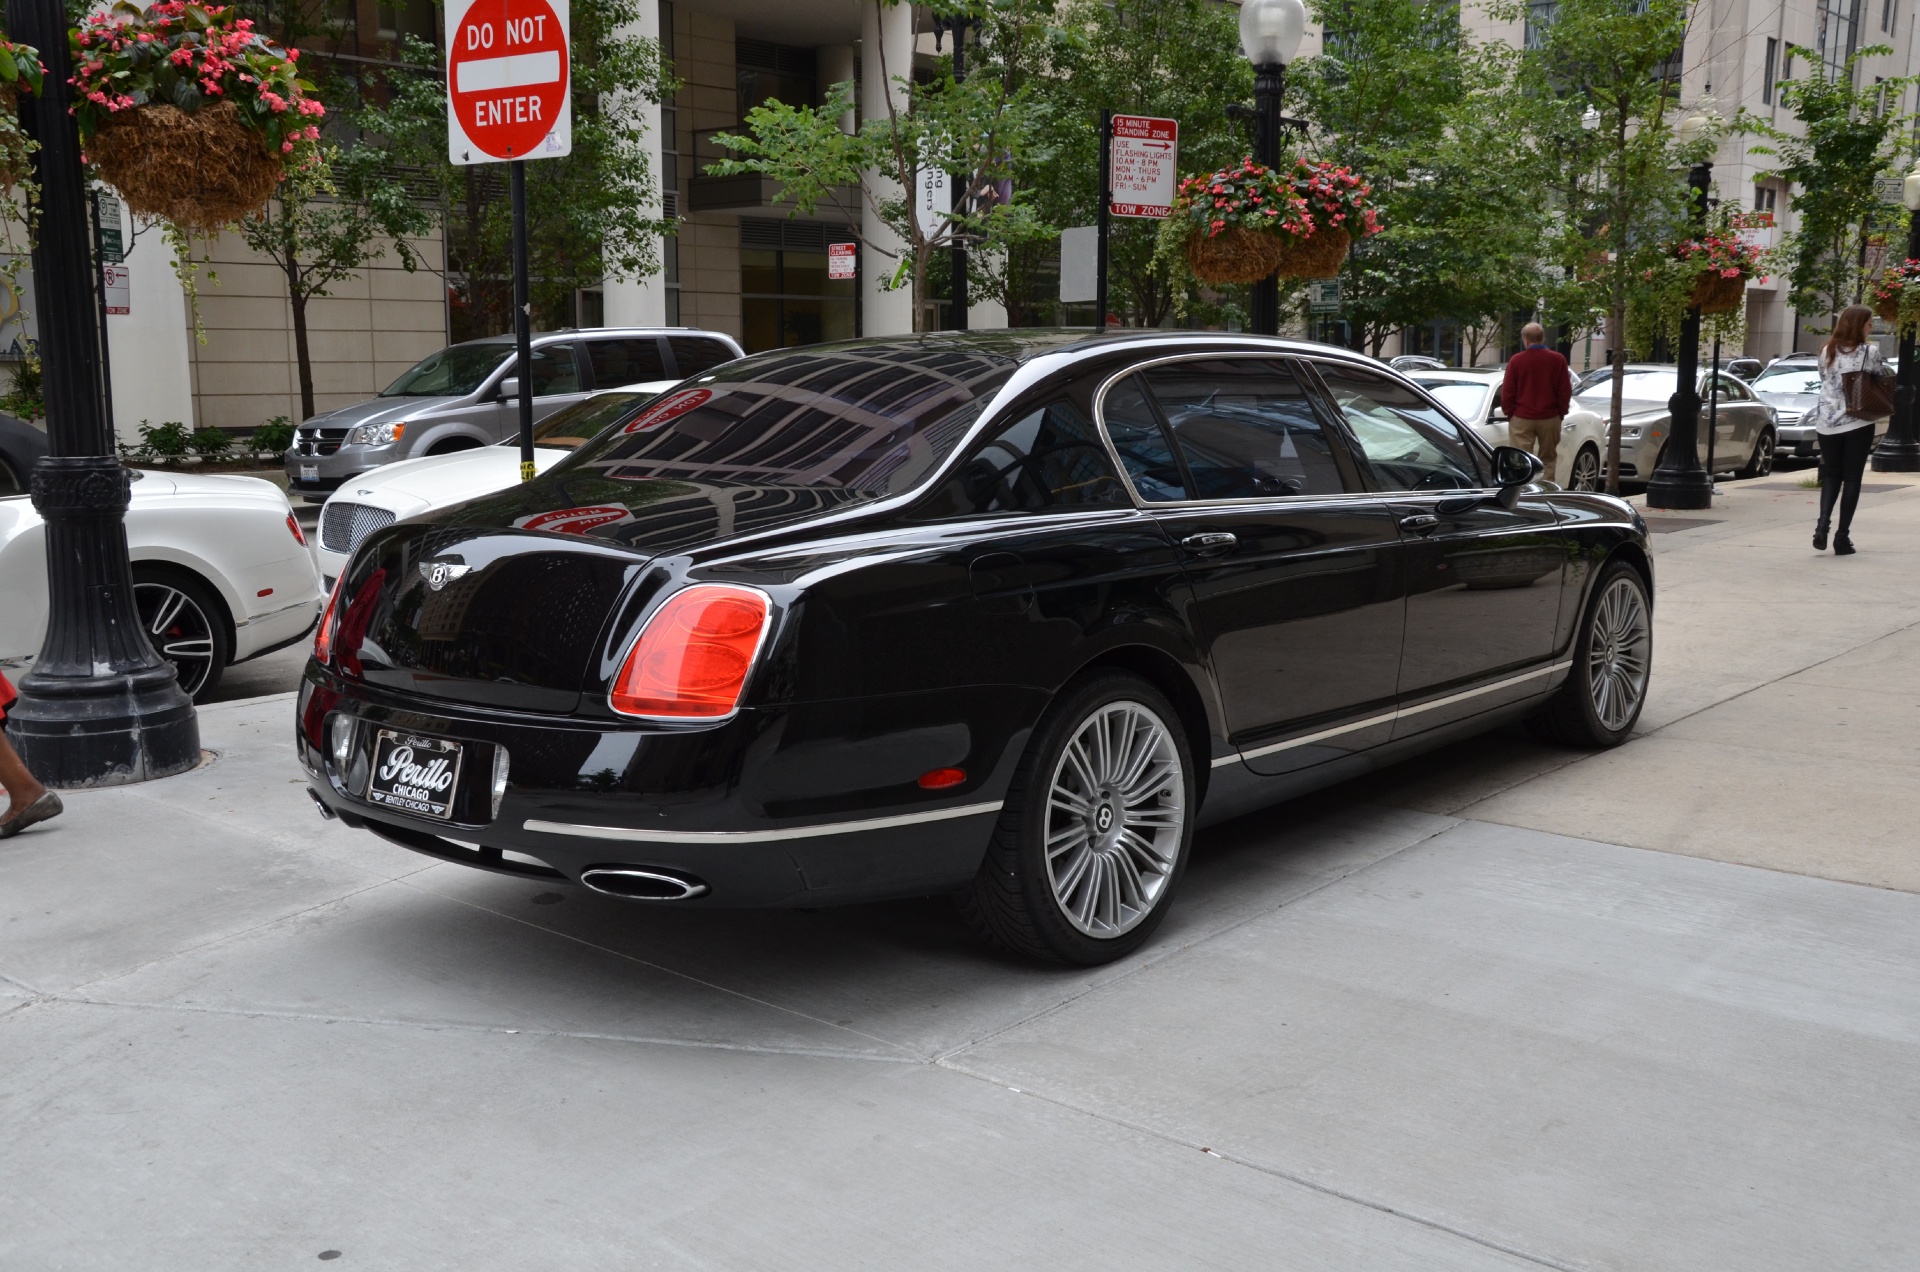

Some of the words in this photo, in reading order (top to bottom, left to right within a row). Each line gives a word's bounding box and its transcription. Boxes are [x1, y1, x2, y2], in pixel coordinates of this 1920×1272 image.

[467, 22, 494, 50] DO
[506, 15, 546, 46] NOT
[475, 95, 542, 127] ENTER
[1117, 118, 1124, 127] 15
[1126, 120, 1150, 128] MINUTE
[1117, 127, 1149, 137] STANDING
[1152, 130, 1170, 139] ZONE
[1116, 140, 1130, 148] USE
[1116, 149, 1148, 158] FLASHING
[1150, 152, 1172, 160] LIGHTS
[1115, 166, 1131, 174] MON
[1138, 167, 1160, 176] THURS
[1114, 204, 1136, 214] TOW
[1142, 206, 1169, 216] ZONE
[404, 736, 432, 748] Perillo
[380, 746, 452, 792] Perillo
[392, 784, 430, 800] CHICAGO
[384, 795, 405, 806] BENTLEY
[405, 800, 430, 812] CHICAGO
